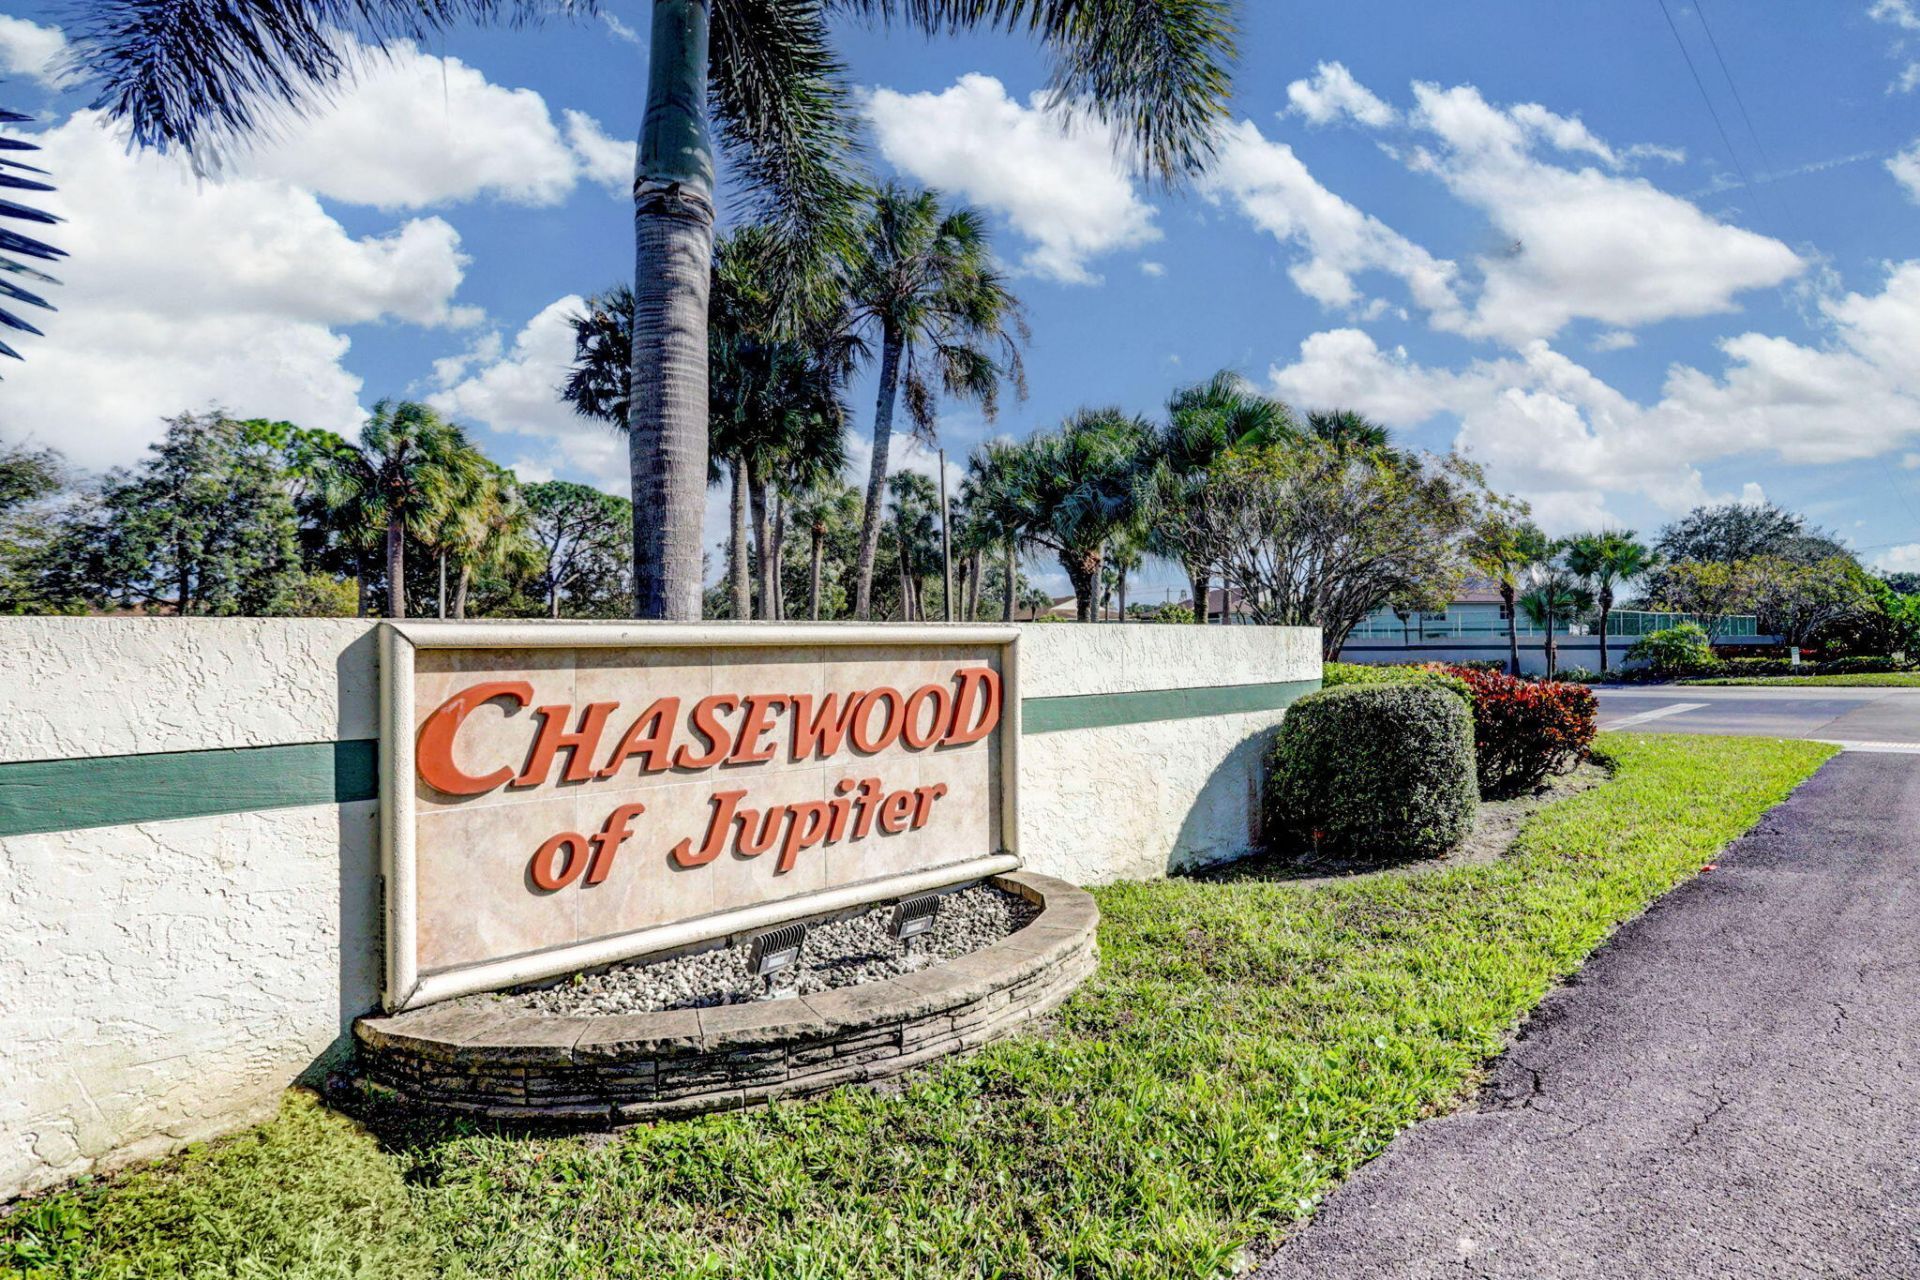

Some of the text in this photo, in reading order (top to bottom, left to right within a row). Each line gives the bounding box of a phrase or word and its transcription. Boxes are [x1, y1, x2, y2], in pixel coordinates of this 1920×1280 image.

[415, 668, 1002, 795] CHASEWOOD
[529, 778, 947, 890] of Jupiter
